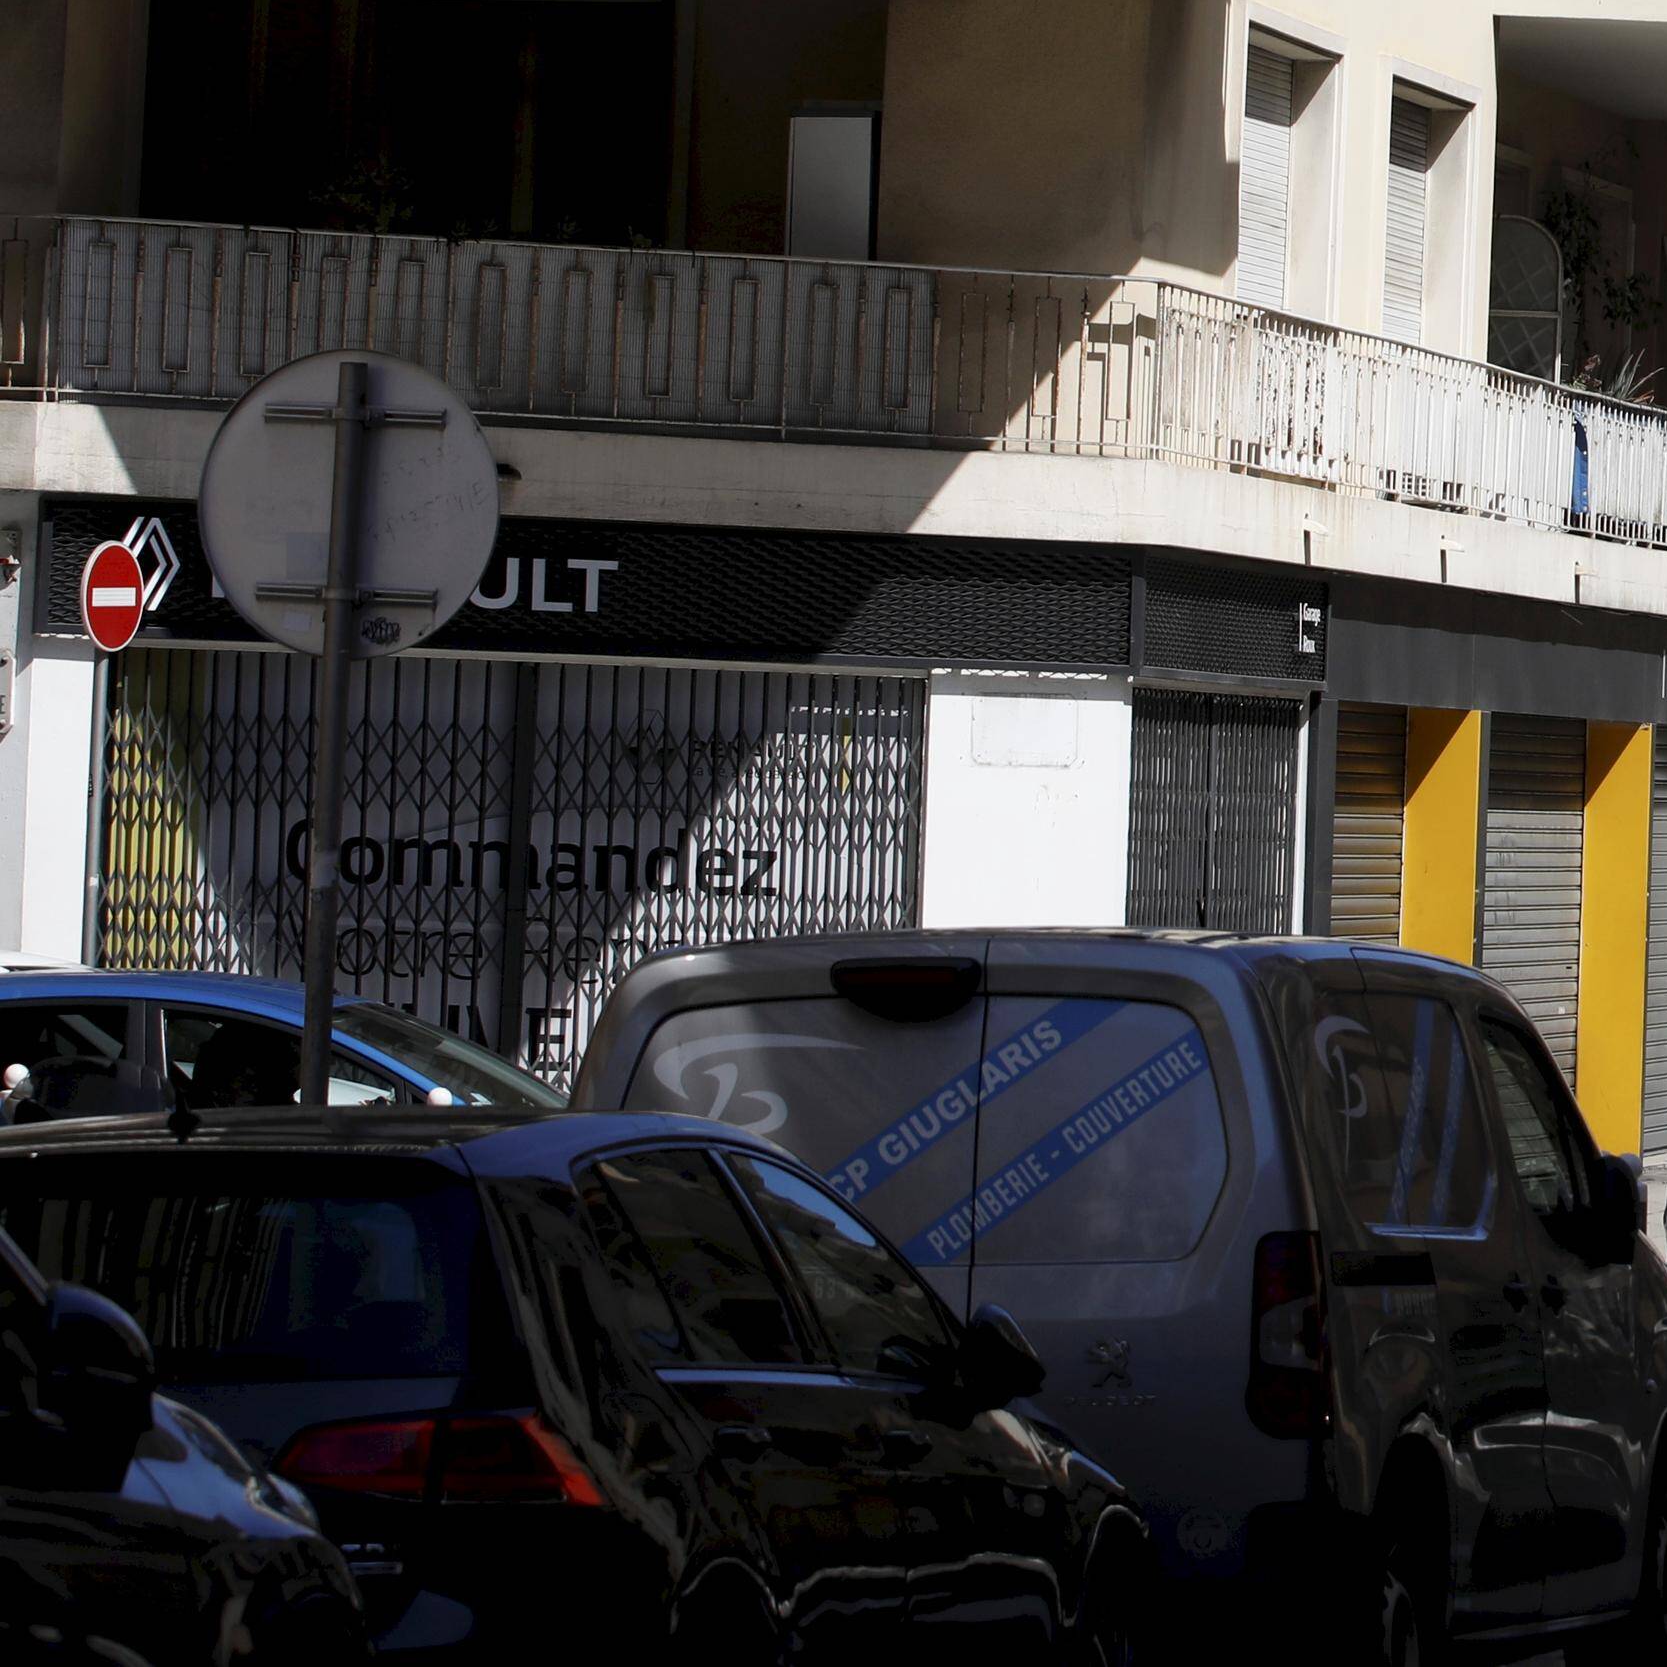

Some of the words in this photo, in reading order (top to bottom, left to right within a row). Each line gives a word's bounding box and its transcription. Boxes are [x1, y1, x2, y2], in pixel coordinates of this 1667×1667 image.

[1303, 602, 1321, 627] Garage
[878, 1019, 1063, 1167] GIUGLARIS
[926, 1151, 1051, 1261] PLOMBERIE
[1062, 1039, 1204, 1154] COUVERTURE
